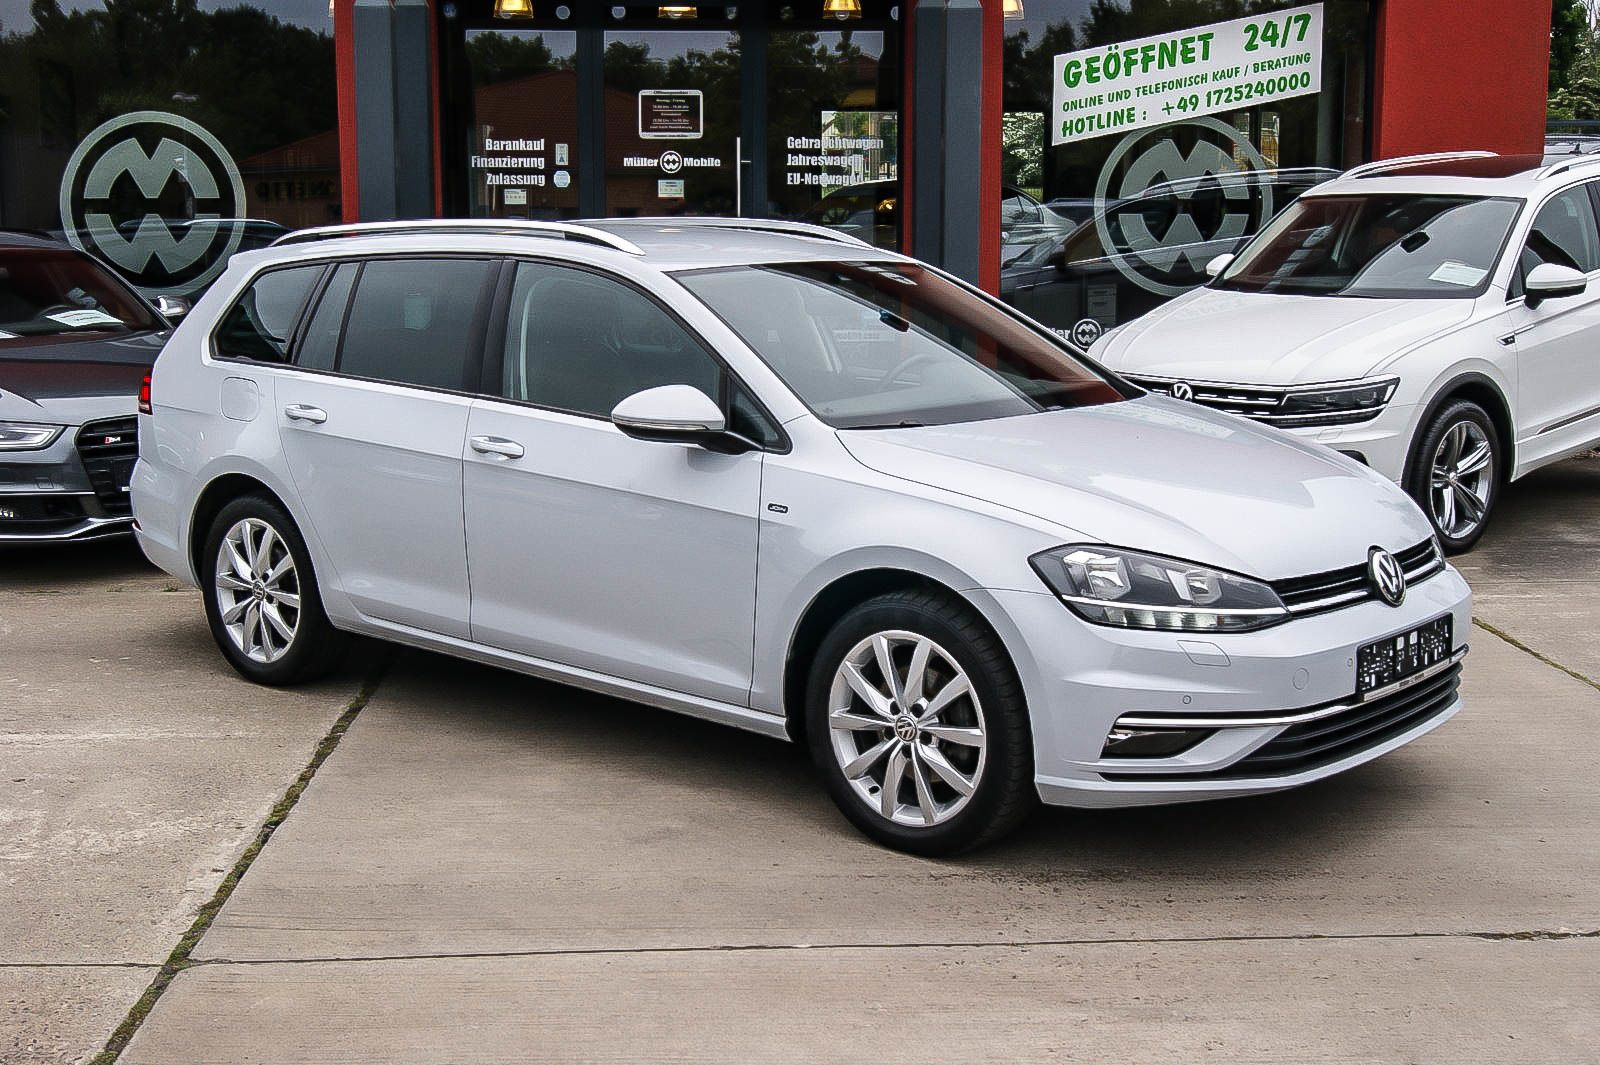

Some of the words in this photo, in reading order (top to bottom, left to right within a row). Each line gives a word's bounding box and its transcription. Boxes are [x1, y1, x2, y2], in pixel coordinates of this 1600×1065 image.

[1063, 32, 1214, 88] GEÖFFNET
[1243, 13, 1312, 52] 24/7
[1062, 94, 1104, 112] ONLINE
[1108, 89, 1132, 103] UND
[1135, 73, 1208, 97] TELEFONISCH
[1212, 66, 1241, 82] KAUF
[1243, 64, 1249, 77] /
[1253, 52, 1312, 73] BERATUNG
[1061, 107, 1136, 137] HOTLINE
[1162, 94, 1200, 115] +49
[1206, 71, 1311, 107] 1725240000
[471, 155, 545, 170] Finanzierung
[486, 172, 546, 187] Zulassung
[623, 156, 658, 167] Müller
[683, 156, 721, 167] Mobile
